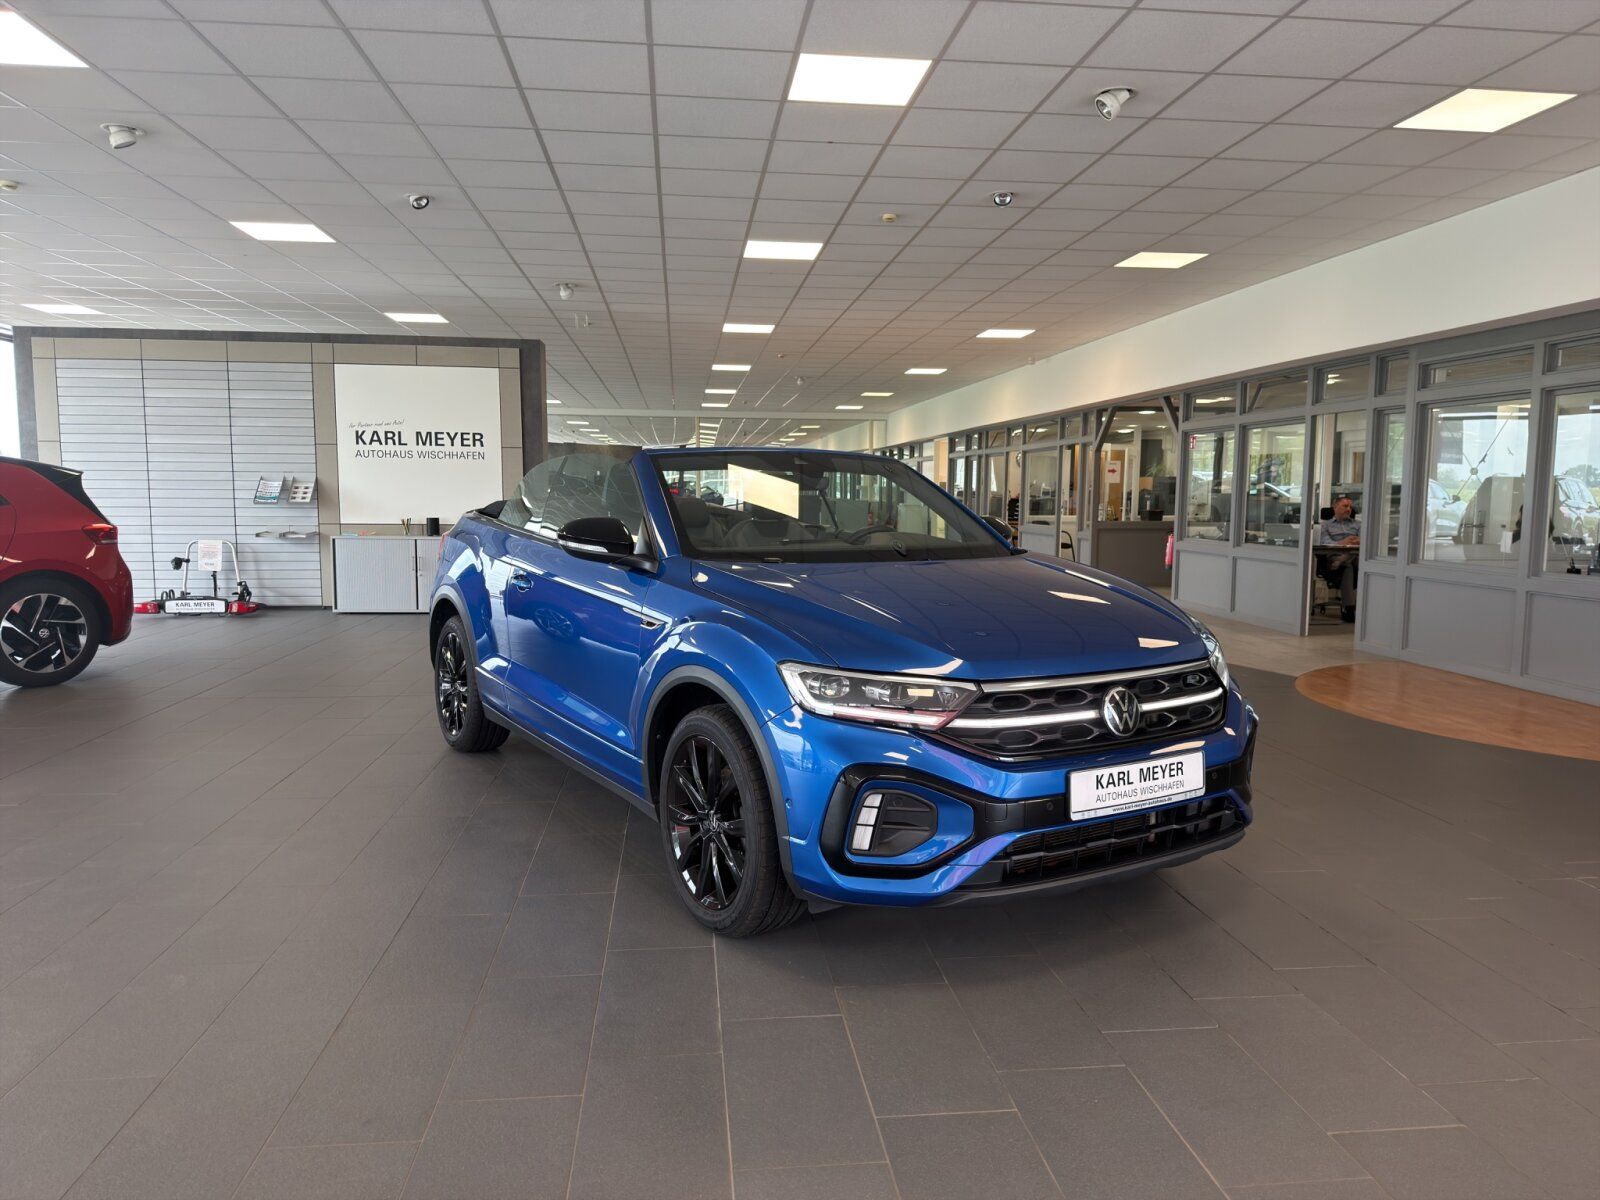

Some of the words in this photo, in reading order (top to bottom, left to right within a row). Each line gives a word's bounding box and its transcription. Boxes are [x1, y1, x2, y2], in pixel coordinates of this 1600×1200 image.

[355, 430, 408, 446] KARL
[415, 431, 485, 448] MEYER
[355, 449, 414, 459] AUTOHAUS
[416, 450, 485, 460] WISCHHAFEN
[1095, 769, 1134, 791] KARL
[1139, 761, 1184, 783] MEYER
[1095, 788, 1138, 803] AUTOHAUS
[1140, 779, 1185, 797] WISCHHAFEN
